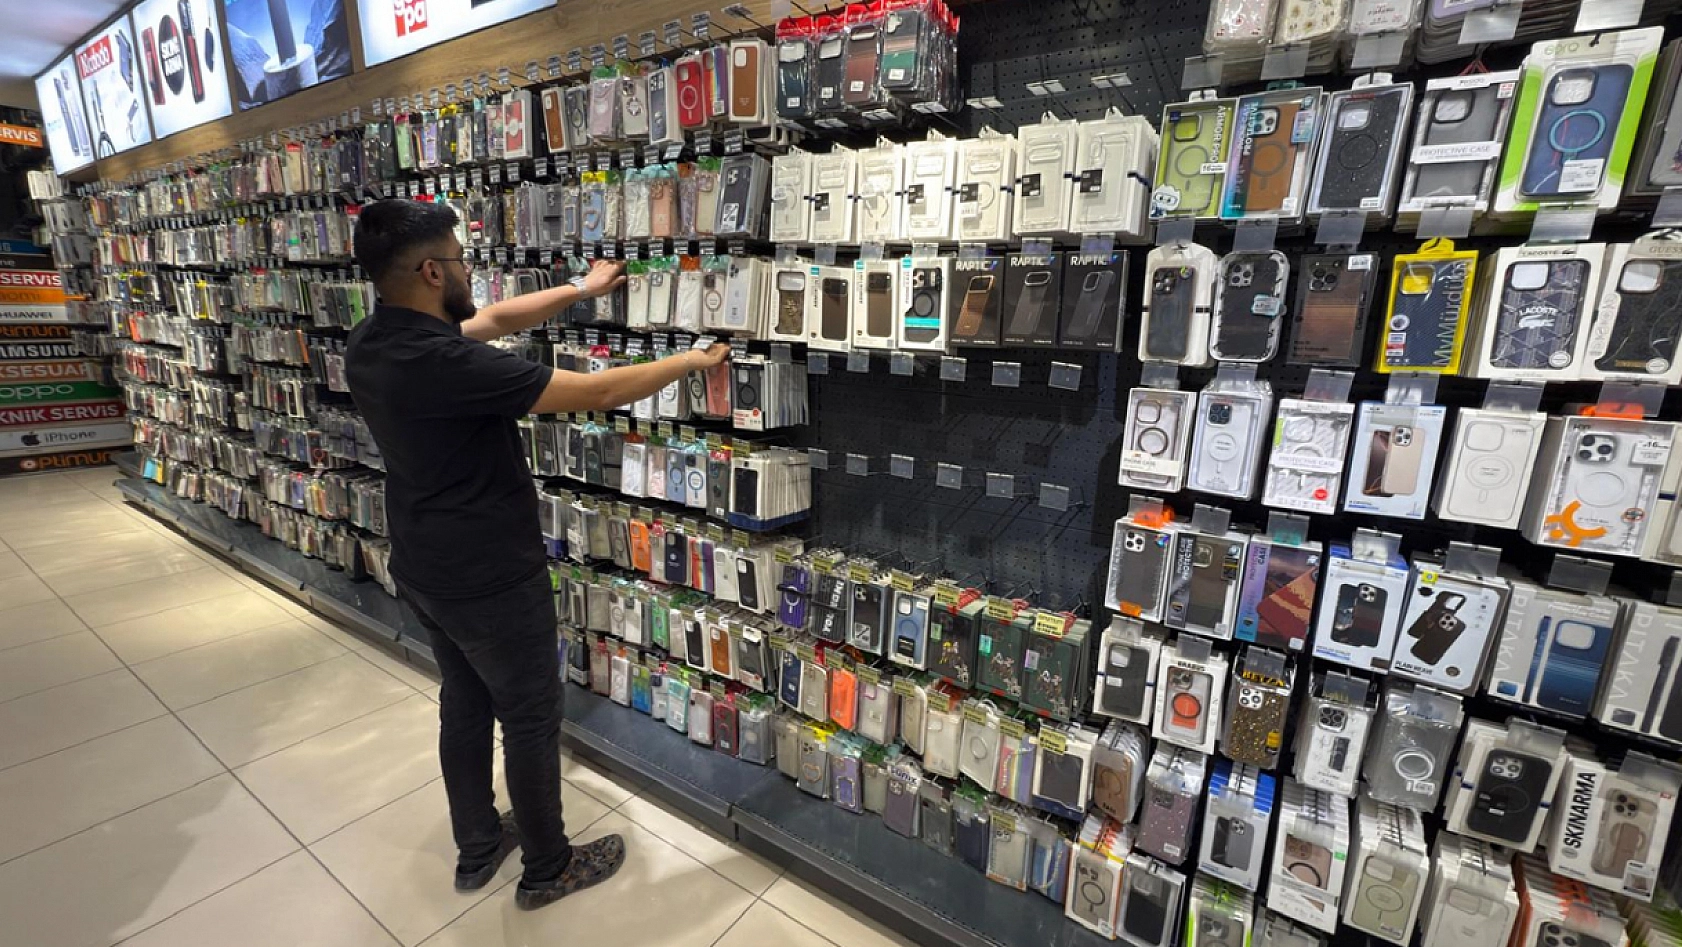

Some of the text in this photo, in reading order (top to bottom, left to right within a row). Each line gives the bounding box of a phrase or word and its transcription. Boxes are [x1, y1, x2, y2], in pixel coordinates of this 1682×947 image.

[1209, 105, 1226, 163] ARMOR PRO
[1470, 145, 1491, 153] CASE
[1519, 306, 1559, 316] LACOSTE
[44, 431, 97, 443] iPhone
[1257, 547, 1267, 565] CASE
[1565, 772, 1597, 849] SKINARMA
